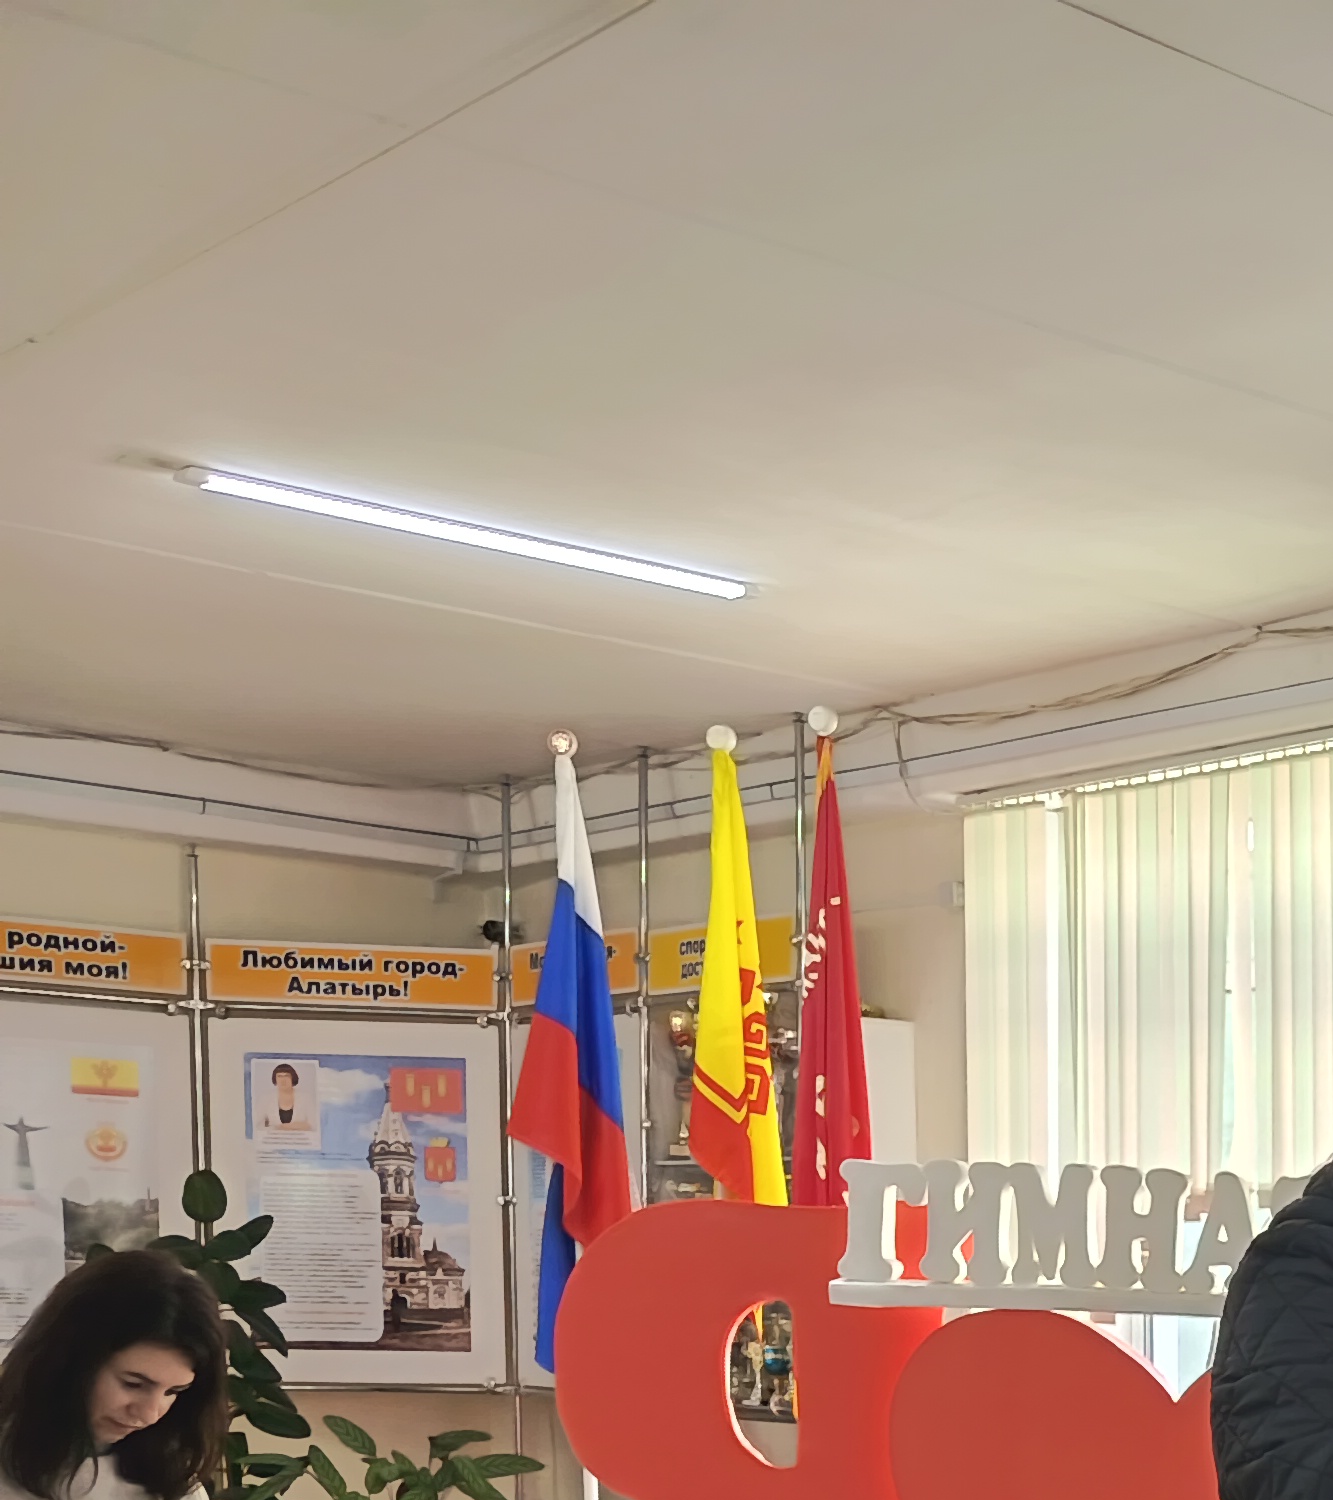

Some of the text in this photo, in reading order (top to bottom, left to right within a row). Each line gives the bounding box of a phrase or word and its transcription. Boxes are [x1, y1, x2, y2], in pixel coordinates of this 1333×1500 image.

[7, 930, 127, 953] родной-
[64, 961, 128, 980] моя!
[240, 949, 466, 979] Любимый город-
[287, 976, 409, 1000] Алатырь!
[838, 1158, 1312, 1294] ГИМНА
